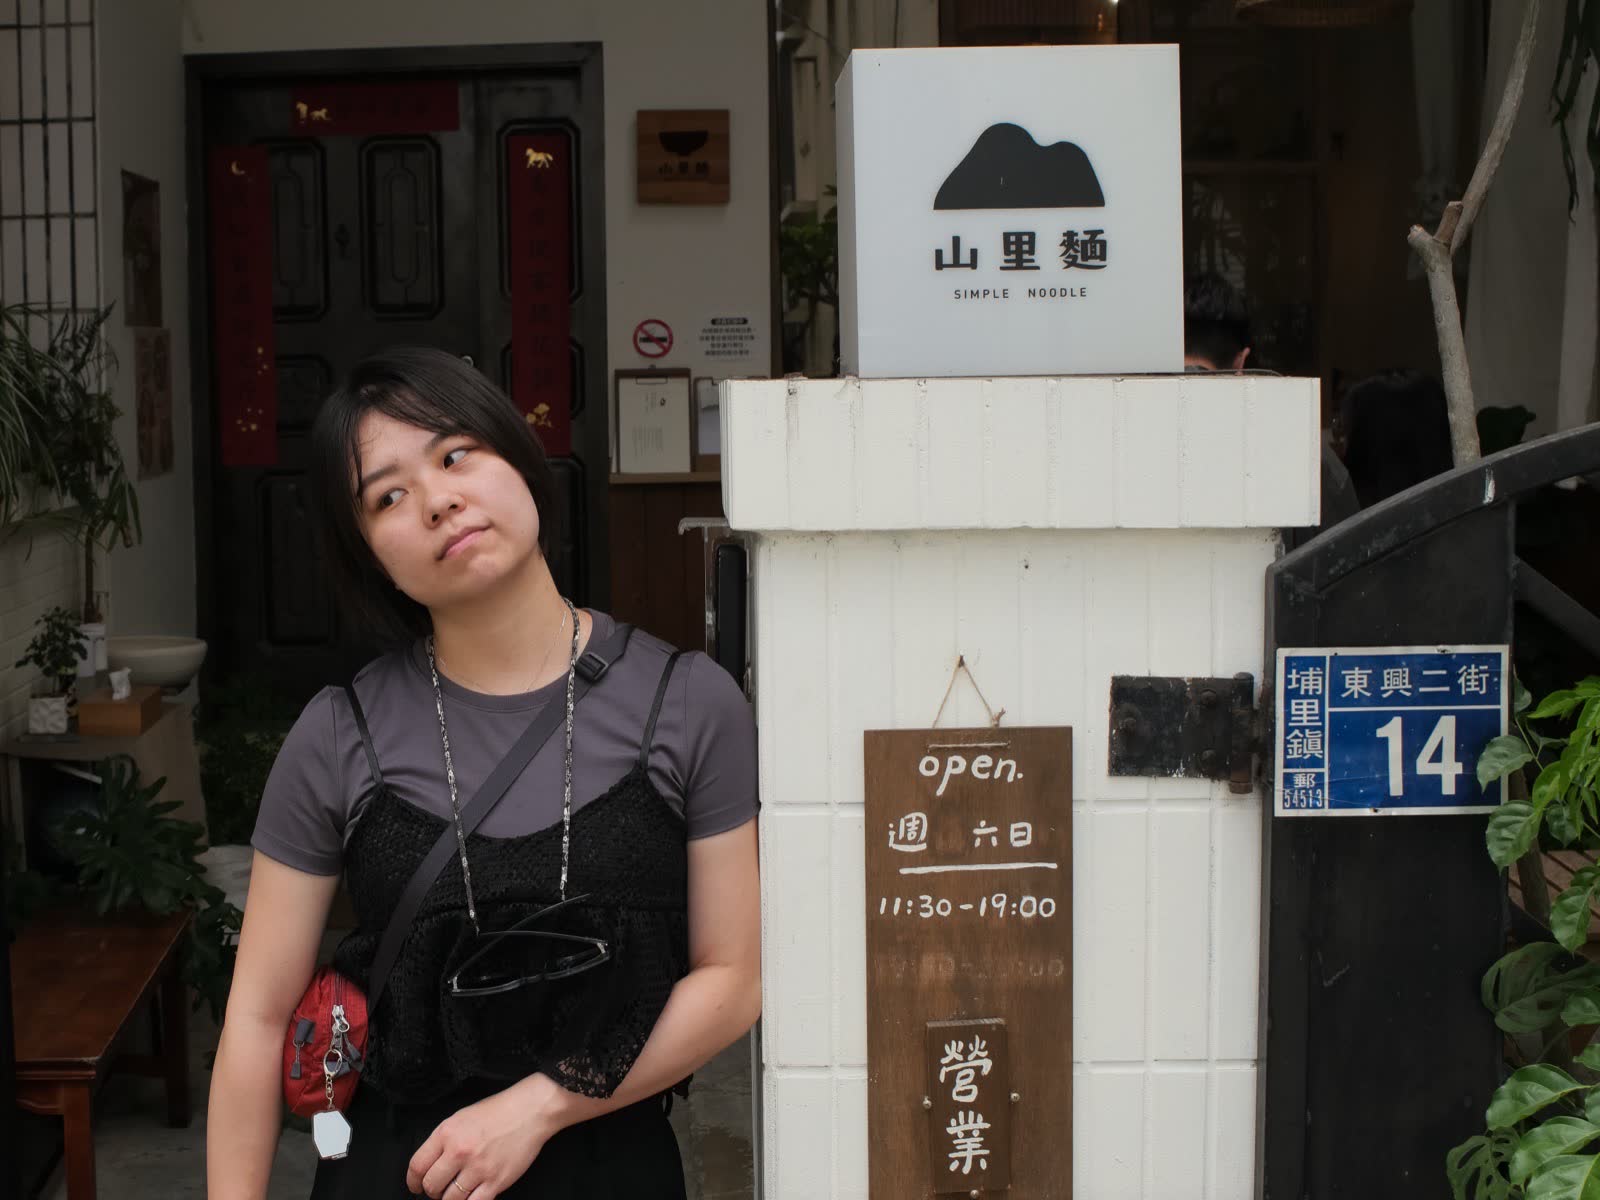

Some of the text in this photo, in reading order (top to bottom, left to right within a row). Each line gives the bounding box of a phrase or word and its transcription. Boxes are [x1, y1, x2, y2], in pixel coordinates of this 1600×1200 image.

[935, 229, 1108, 271] 山里麵
[954, 287, 1088, 300] SIMPLE NOODLE
[1340, 663, 1490, 699] 東興二街
[1375, 714, 1464, 797] 14
[1284, 788, 1324, 808] 54513
[1292, 772, 1316, 789] 郵
[938, 1033, 993, 1175] 營業
